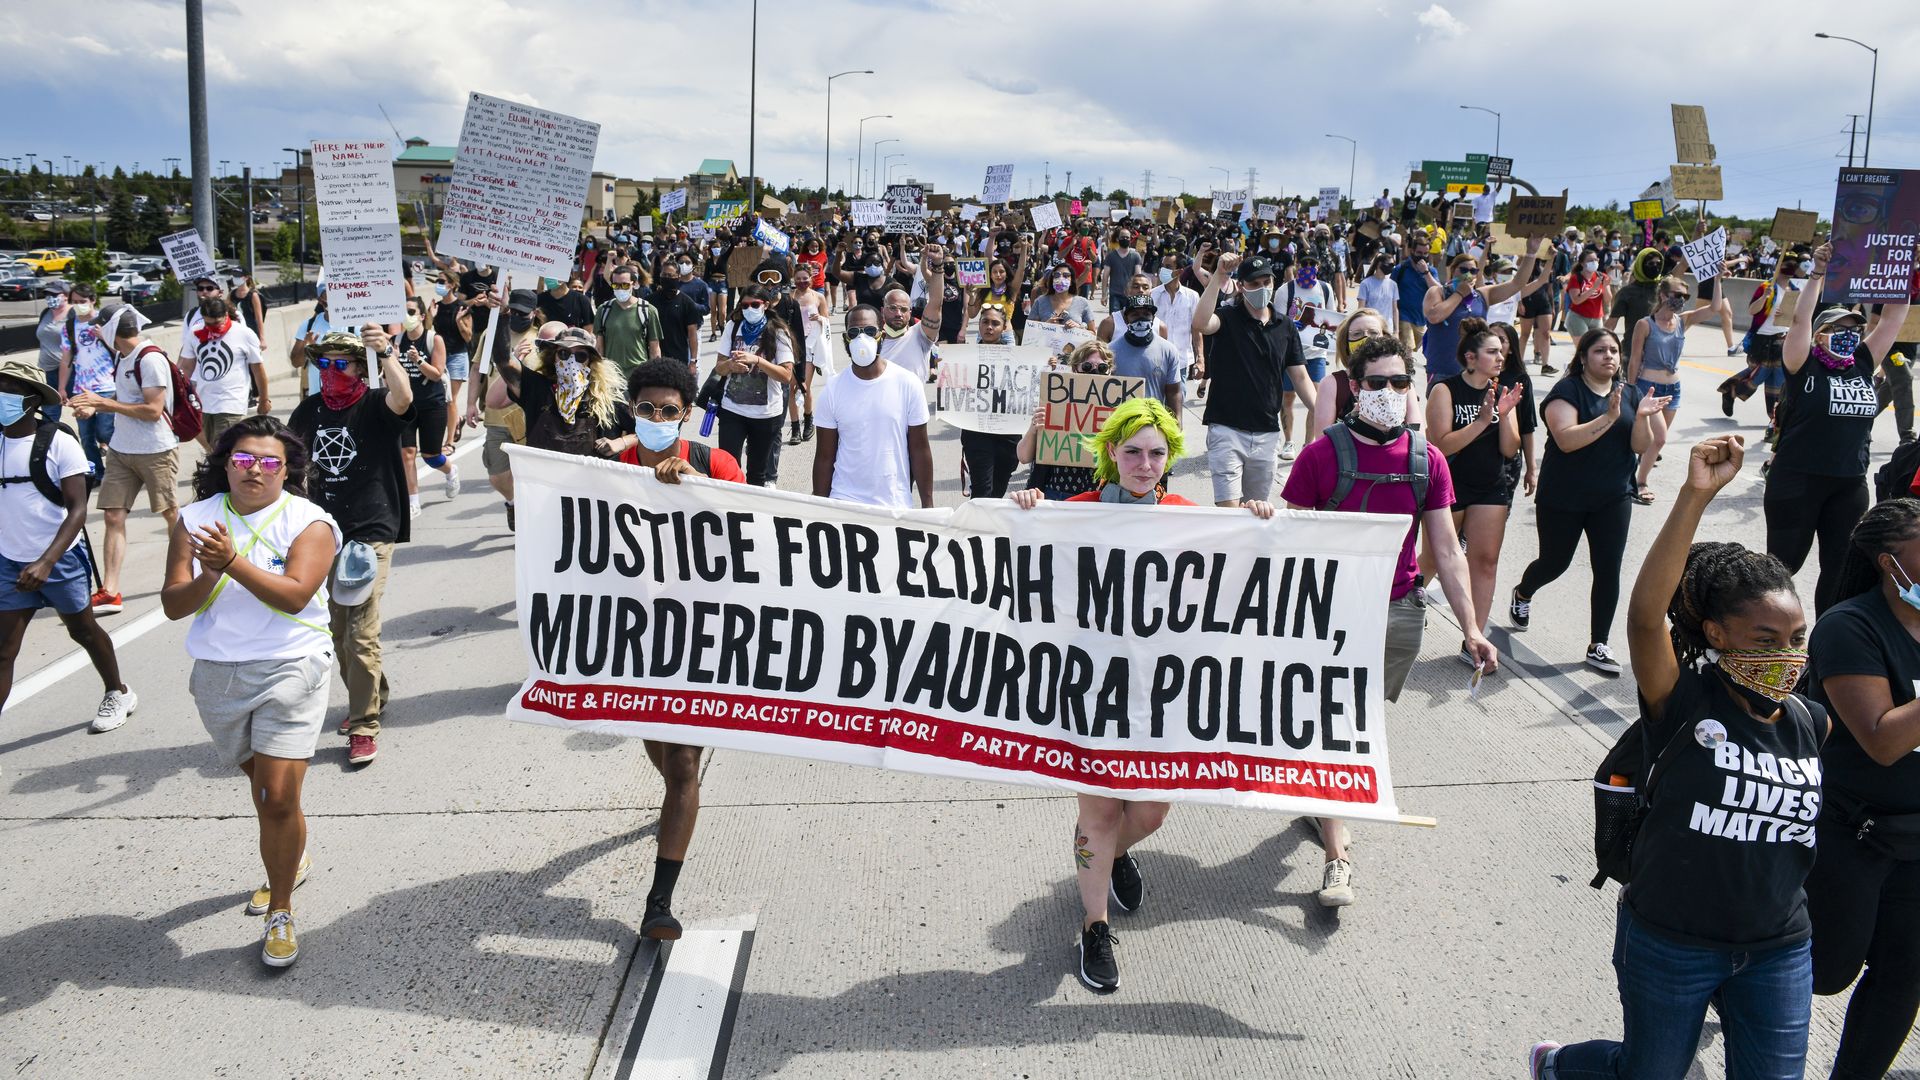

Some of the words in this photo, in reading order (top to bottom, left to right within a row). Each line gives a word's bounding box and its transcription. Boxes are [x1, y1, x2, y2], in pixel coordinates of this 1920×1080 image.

[508, 112, 530, 124] ELIJAH
[1678, 126, 1708, 140] LIVES
[314, 143, 339, 153] HERE
[464, 146, 521, 163] ATTACKING
[514, 146, 533, 156] WHY
[536, 151, 548, 160] ARE
[554, 155, 566, 163] YOU
[472, 173, 504, 186] FORGIVE
[507, 180, 518, 188] ME
[1846, 174, 1863, 182] CAN'T
[891, 186, 922, 197] JUSTICE
[1212, 191, 1231, 200] GIVE
[1236, 190, 1247, 200] US
[555, 196, 572, 206] WILL
[1519, 199, 1553, 208] ABOLISH
[491, 205, 505, 215] AND
[515, 213, 536, 223] LOVE
[535, 208, 549, 217] YOU
[552, 211, 568, 220] ARE
[709, 203, 747, 217] THEY
[892, 205, 921, 214] ELIJAH
[1518, 213, 1557, 225] POLICE
[325, 227, 343, 235] Randy
[466, 225, 483, 236] JUST
[487, 231, 510, 242] CAN'T
[513, 237, 542, 248] BREATHE
[460, 239, 484, 250] ELIJAH
[1684, 230, 1725, 258] BLACK
[1864, 233, 1915, 248] JUSTICE
[1690, 244, 1724, 270] LIVE
[1887, 249, 1912, 261] FOR
[958, 261, 985, 271] TEACH
[1699, 257, 1723, 280] MAT
[1869, 263, 1910, 278] ELIJAH
[959, 271, 986, 284] PEACE!
[1850, 278, 1908, 290] MCCLAIN
[328, 282, 369, 291] REMEMBER
[347, 291, 371, 300] NAMES
[937, 363, 971, 388] ALL
[977, 364, 1040, 392] BLACK
[1048, 373, 1144, 407] BLACK
[1833, 388, 1875, 401] LIVES
[992, 389, 1038, 416] MATTE
[1831, 403, 1876, 415] MATTER
[1045, 403, 1117, 432] LIVE
[1039, 430, 1098, 462] MAT
[554, 496, 759, 584] JUSTICE
[773, 516, 881, 594] FOR
[896, 527, 1055, 624] ELIJAH
[1077, 546, 1346, 656] MCCLAIN,
[529, 592, 824, 692] MURDERED
[838, 614, 915, 702] BY
[902, 621, 1130, 739] AURORA
[1150, 654, 1370, 754] POLICE!
[528, 686, 576, 710] UNITE
[583, 692, 598, 709] &
[602, 692, 659, 713] FIGHT
[661, 696, 686, 714] TO
[690, 698, 728, 717] END
[731, 703, 800, 725] RACIST
[805, 710, 874, 733] POLICE
[961, 731, 1031, 764] PARTY
[1034, 745, 1075, 771] FOR
[1080, 756, 1189, 780] SOCIALISM
[1195, 761, 1239, 780] AND
[1244, 764, 1370, 791] LIBERATION
[1715, 741, 1822, 787] BLACK
[1721, 775, 1820, 821] LIVES
